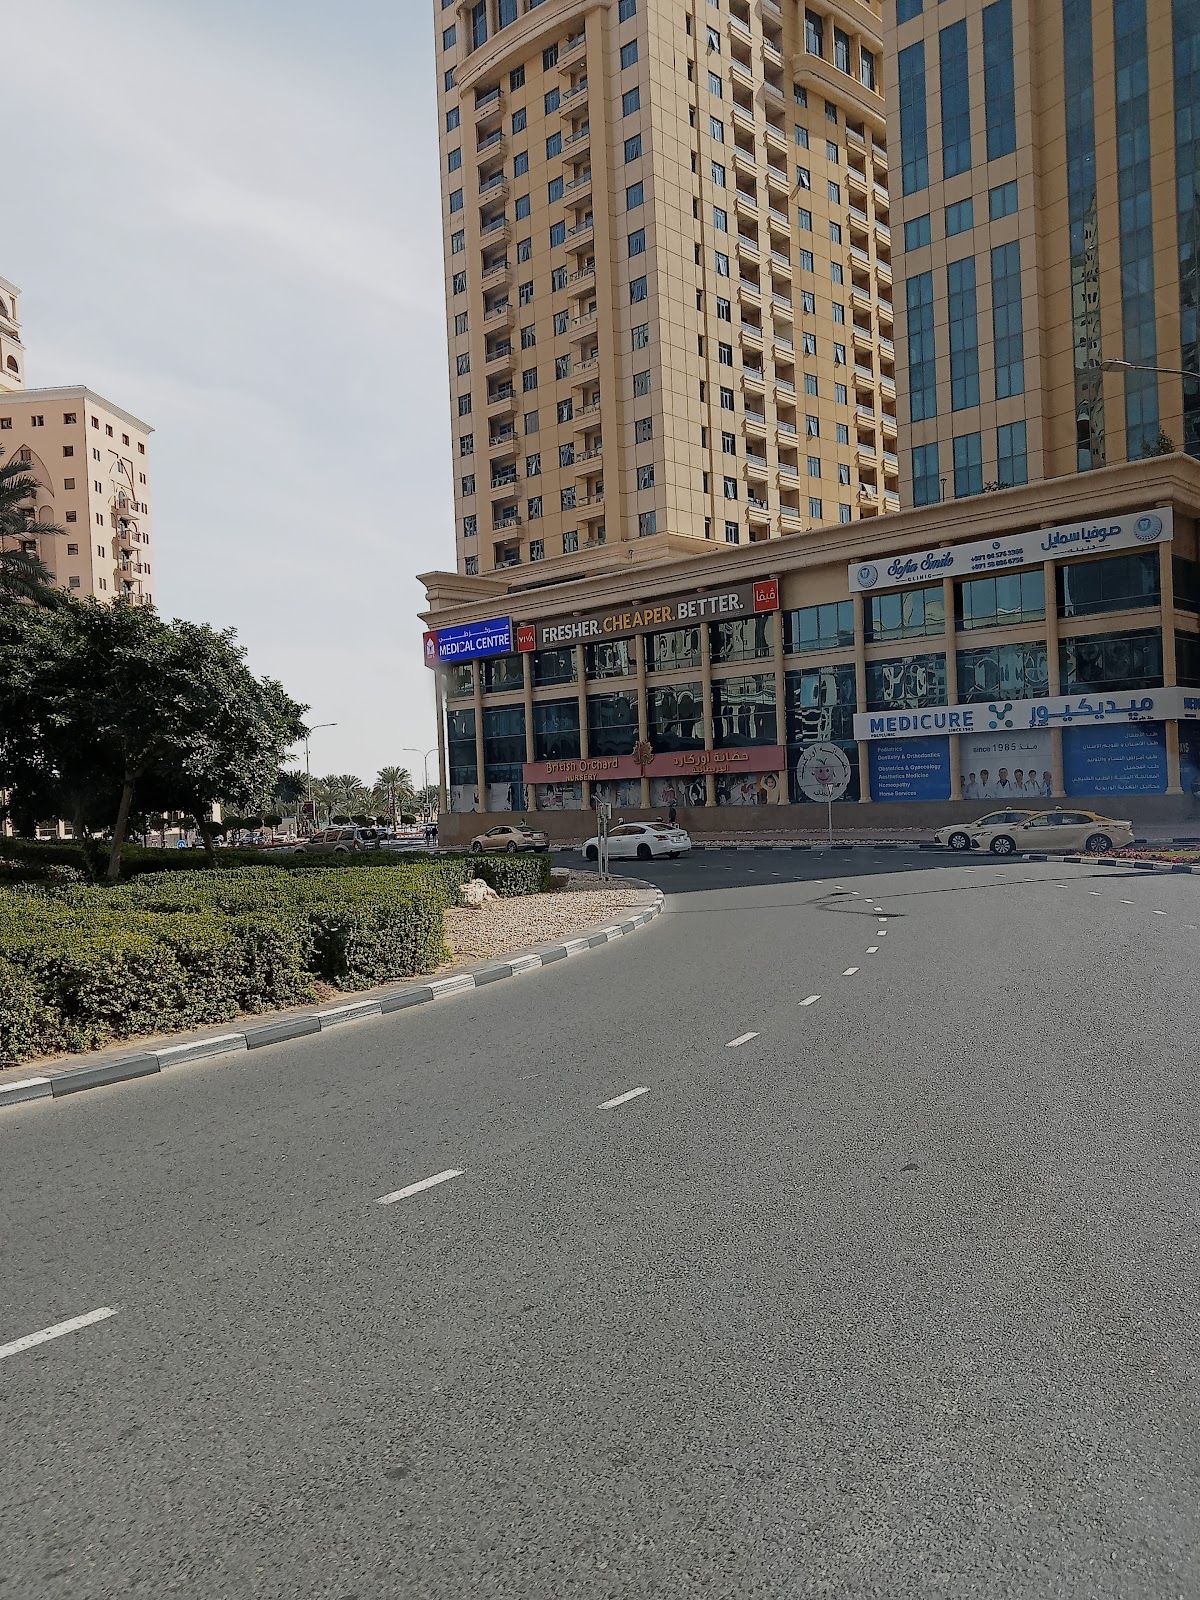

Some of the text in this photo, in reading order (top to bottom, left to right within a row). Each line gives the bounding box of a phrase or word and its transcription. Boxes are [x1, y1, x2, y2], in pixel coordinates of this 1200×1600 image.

[1041, 531, 1080, 551] سمايل
[1081, 525, 1121, 543] صوفيا
[888, 558, 918, 579] Sofia
[921, 552, 954, 571] Smile
[907, 573, 932, 581] CLINIC
[542, 593, 744, 643] FRESHER. CHEAPER. BETTER.
[440, 633, 510, 656] MEDICAL CENTRE
[519, 632, 534, 643] VIVA
[1028, 698, 1153, 725] ميديكيور
[870, 711, 973, 734] MEDICURE
[993, 743, 1016, 751] 1985
[546, 757, 618, 774] British Orchard
[714, 752, 749, 762] حضانة
[566, 774, 597, 782] NURSERY
